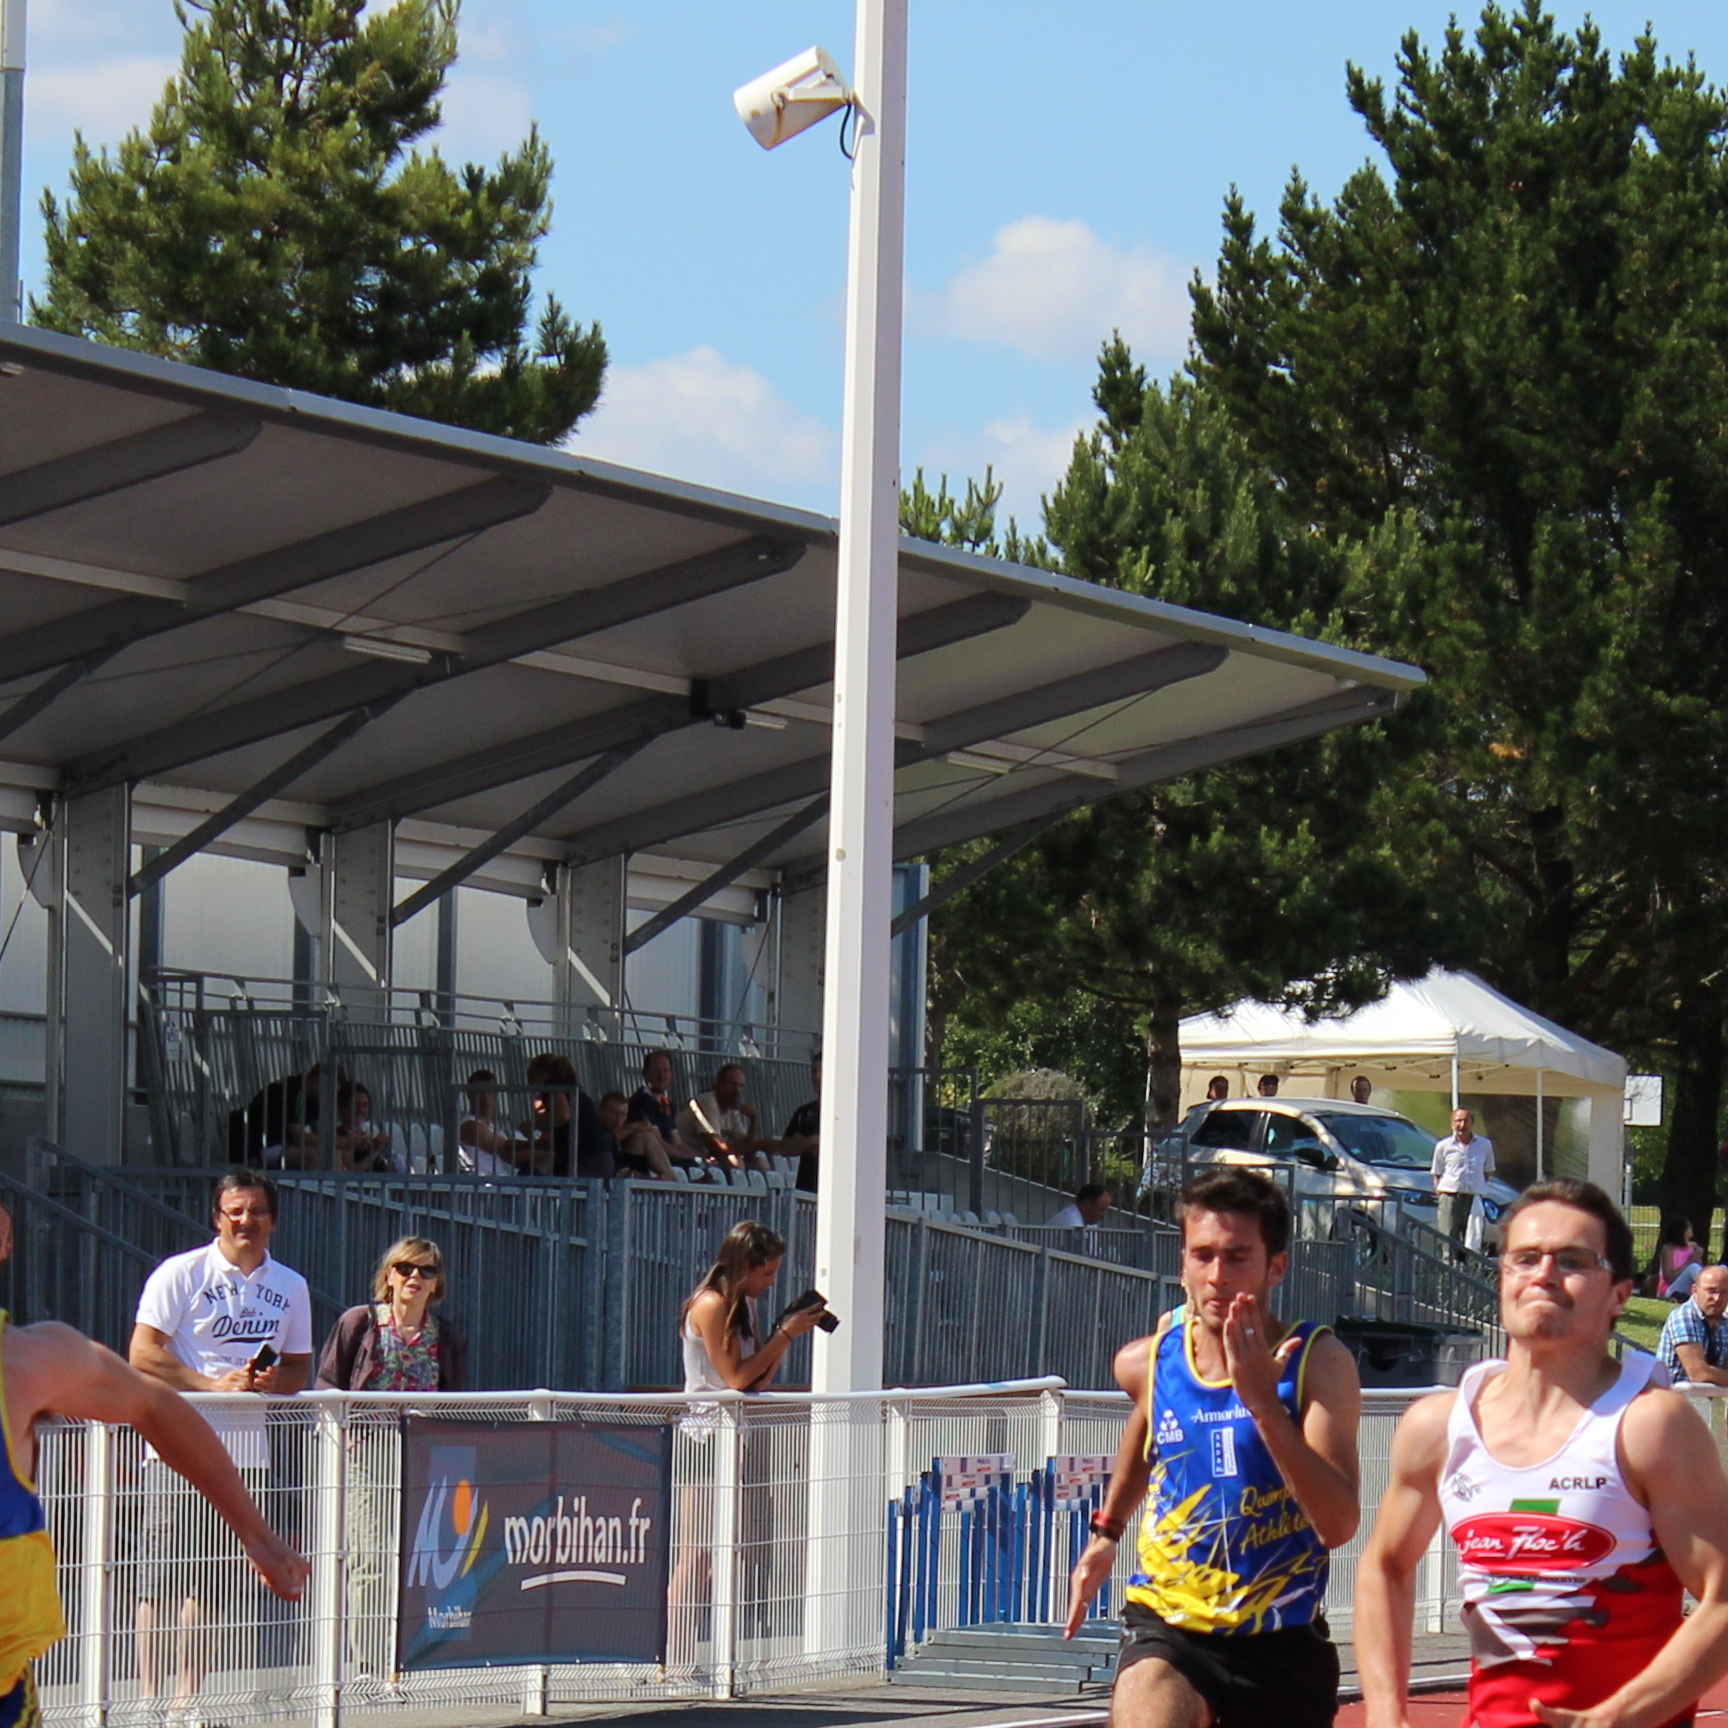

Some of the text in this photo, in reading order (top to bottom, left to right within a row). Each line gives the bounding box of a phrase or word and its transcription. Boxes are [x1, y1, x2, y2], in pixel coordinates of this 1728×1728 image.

[203, 1281, 239, 1305] NEW
[211, 1314, 280, 1339] Denim
[1156, 1428, 1184, 1445] CMB
[1548, 1476, 1608, 1491] ACRLP
[1240, 1485, 1295, 1518] Quimp
[504, 1495, 651, 1565] morbihan.fr
[1457, 1525, 1588, 1561] jean Floc'h
[427, 1605, 472, 1629] Morbihan
